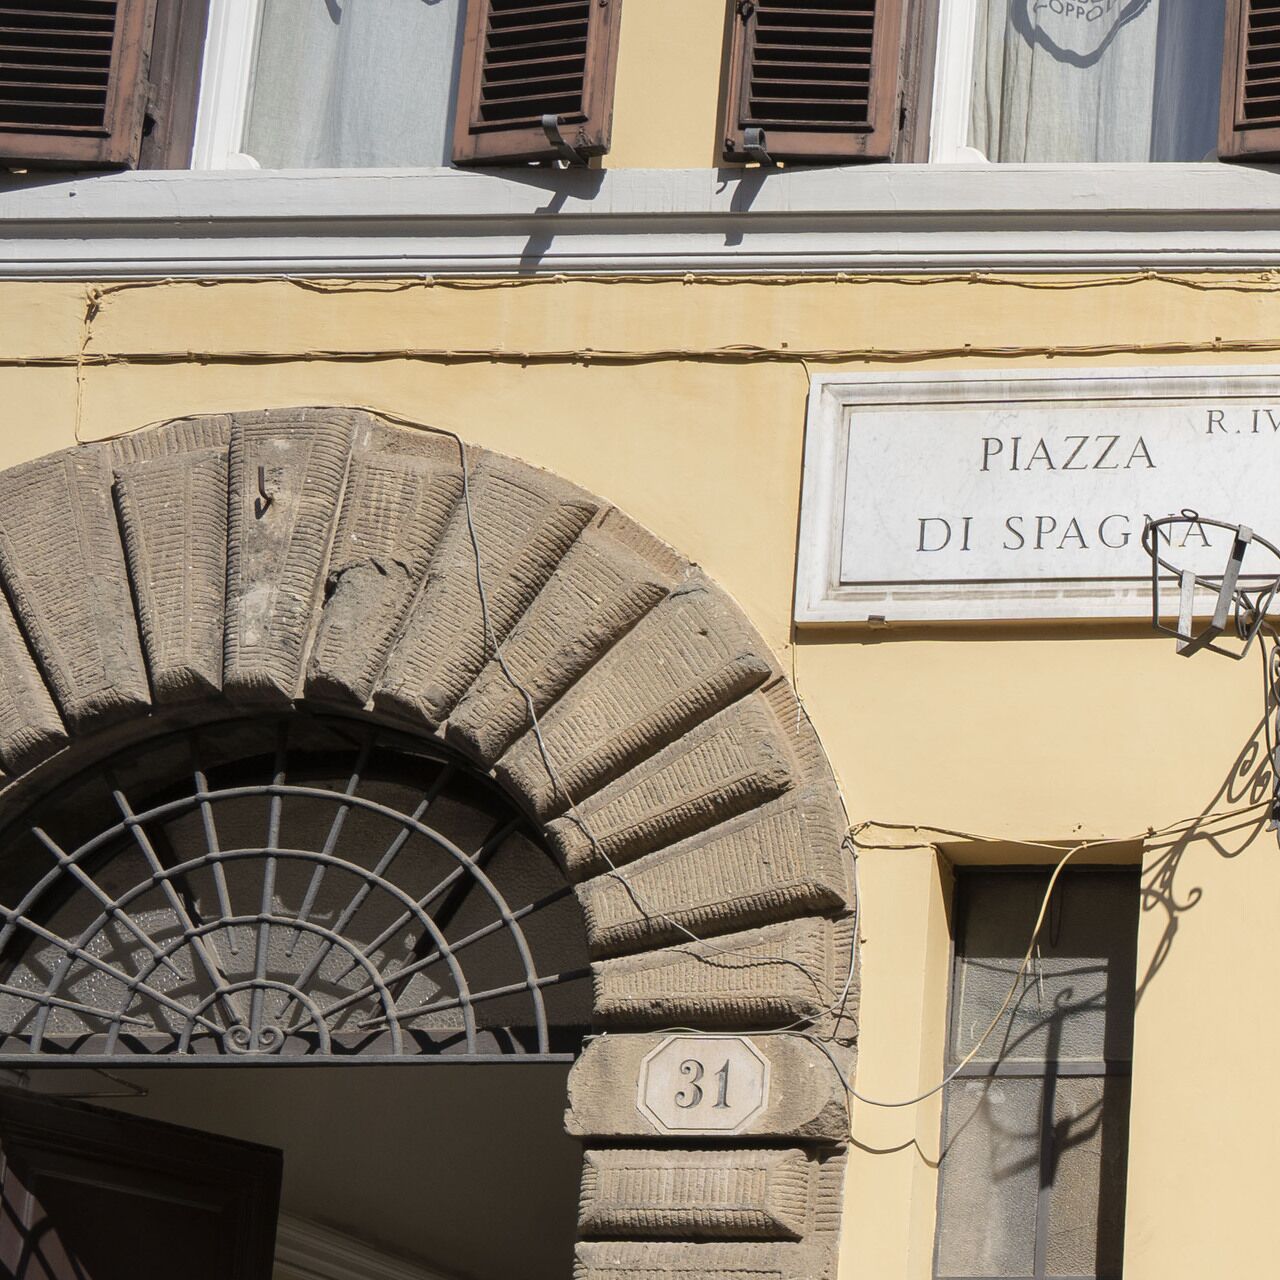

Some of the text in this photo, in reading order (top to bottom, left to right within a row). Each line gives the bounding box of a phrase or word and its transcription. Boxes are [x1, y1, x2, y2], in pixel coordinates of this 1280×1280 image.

[979, 435, 1157, 472] PIAZZA
[916, 513, 1212, 552] DI SPAGNA
[675, 1058, 732, 1109] 31
